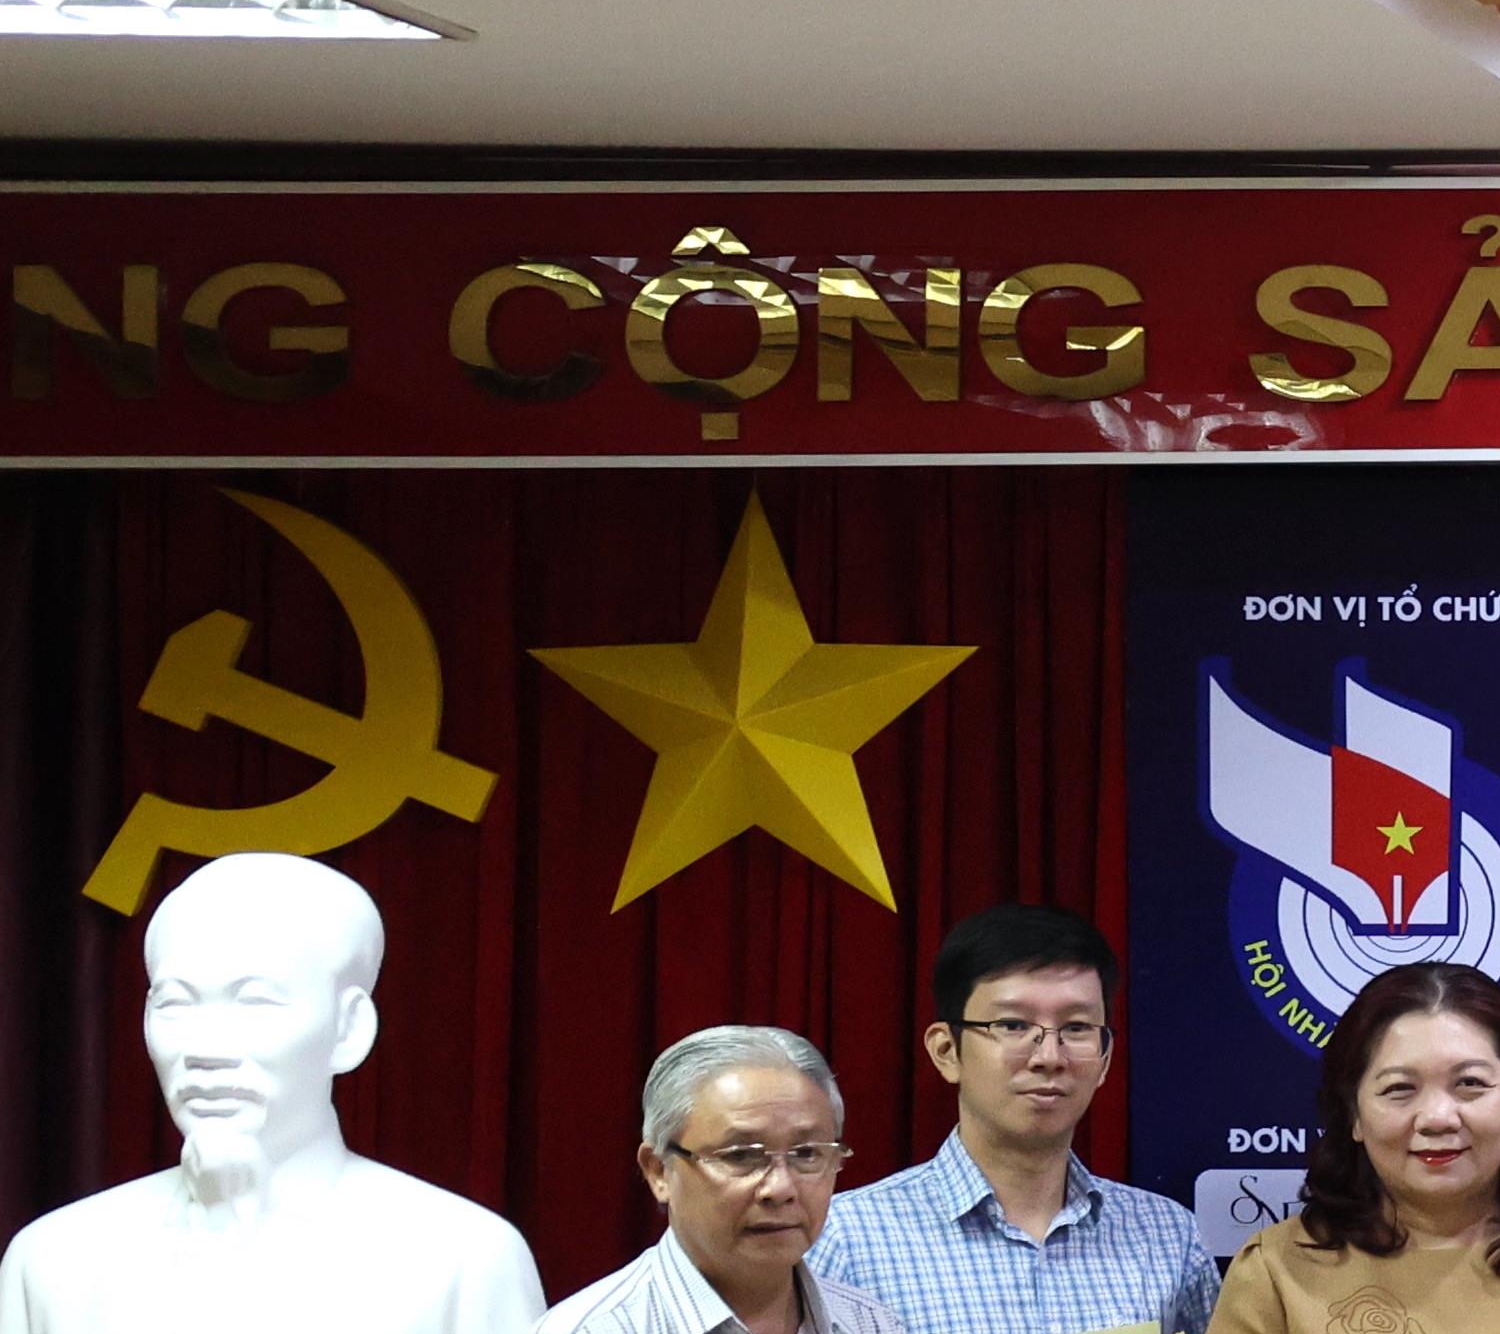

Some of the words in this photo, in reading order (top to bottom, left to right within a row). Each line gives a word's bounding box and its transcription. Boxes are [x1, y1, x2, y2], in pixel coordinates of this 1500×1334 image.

[448, 226, 1146, 441] CỘNG
[1243, 593, 1322, 621] ĐƠN
[1333, 596, 1366, 627] VỊ
[1377, 583, 1422, 621] TỔ
[1244, 939, 1287, 998] HỘI
[1227, 1126, 1306, 1154] ĐƠN
